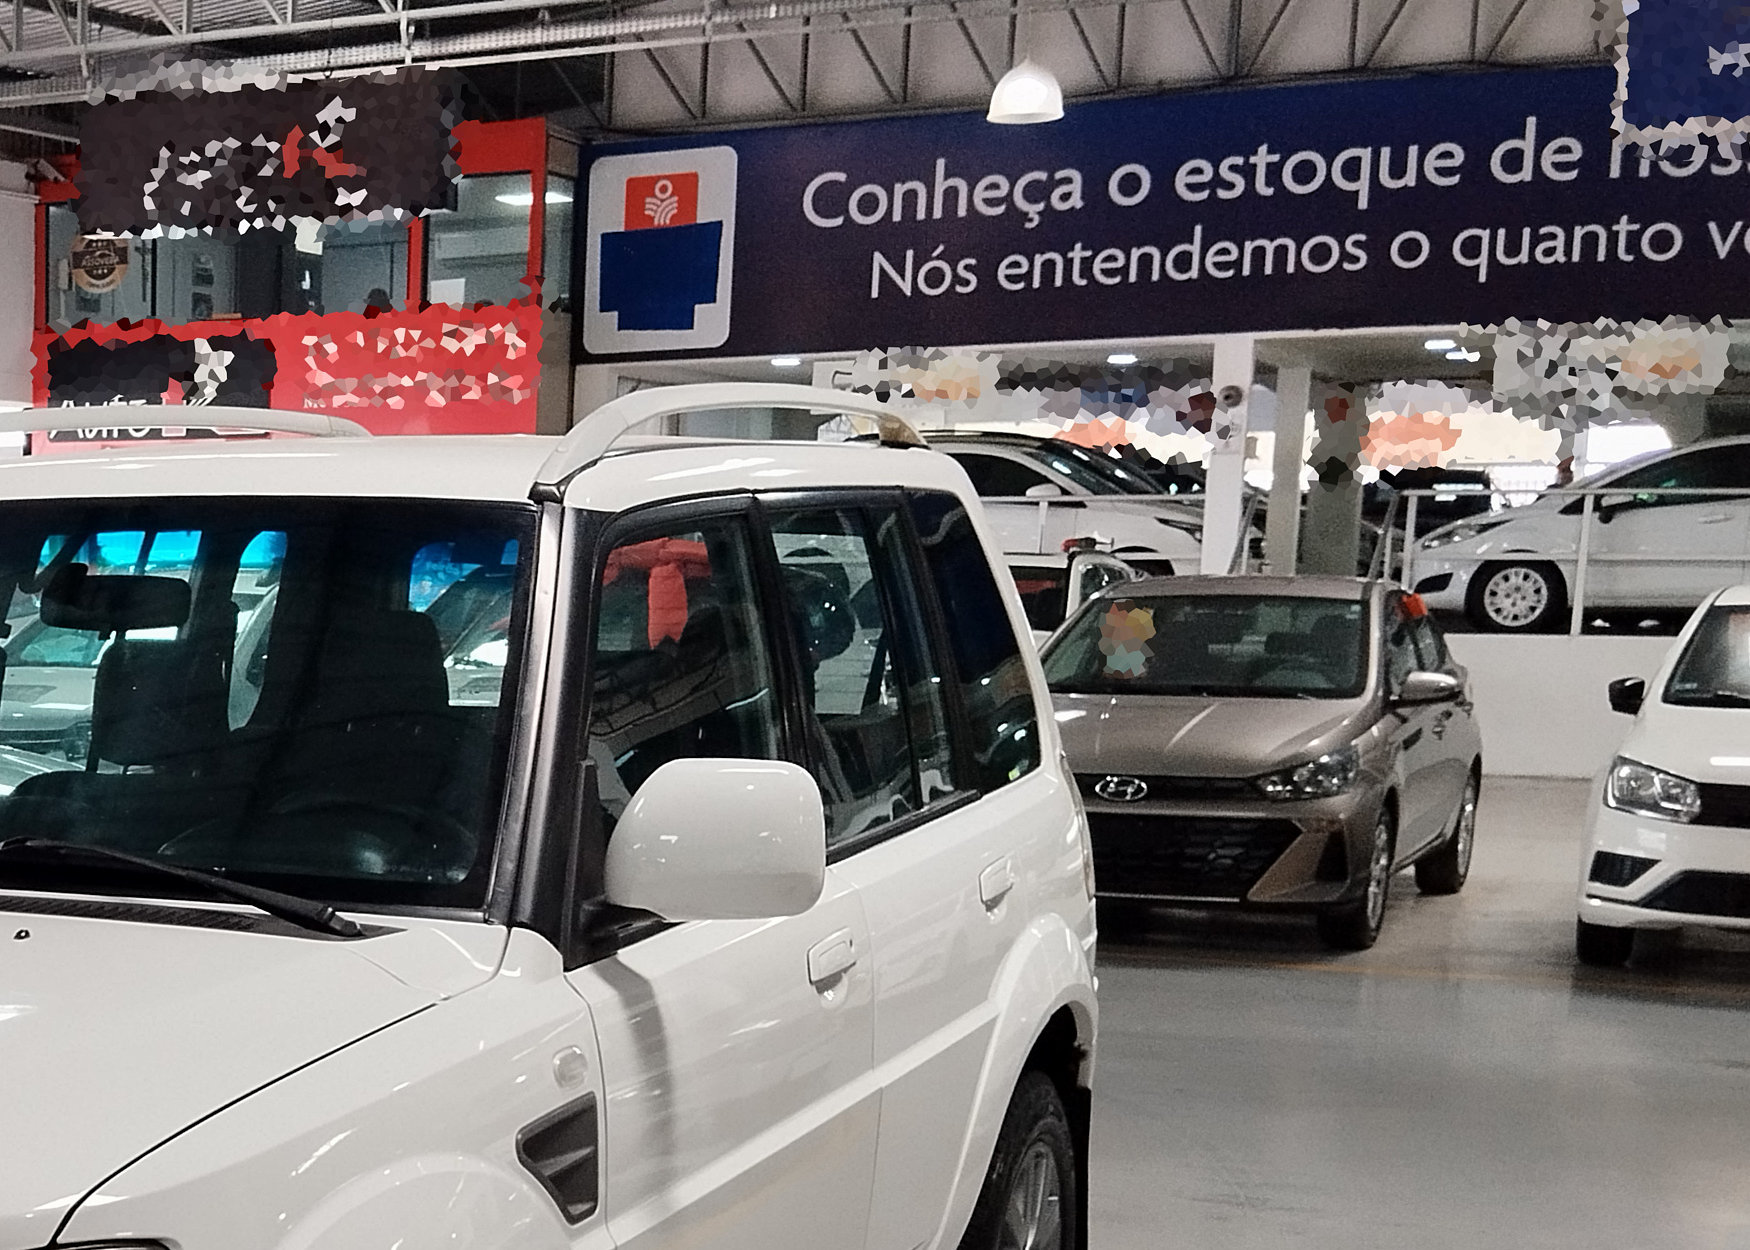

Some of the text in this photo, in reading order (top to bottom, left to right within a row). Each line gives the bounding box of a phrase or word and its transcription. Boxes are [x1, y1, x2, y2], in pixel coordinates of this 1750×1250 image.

[802, 157, 1085, 229] Conheça
[1108, 163, 1151, 206] o
[1174, 143, 1465, 210] estoque
[1490, 116, 1583, 184] de
[871, 244, 978, 299] Nós
[997, 224, 1368, 291] entendemos
[1390, 230, 1430, 269] o
[1452, 214, 1683, 283] quanto
